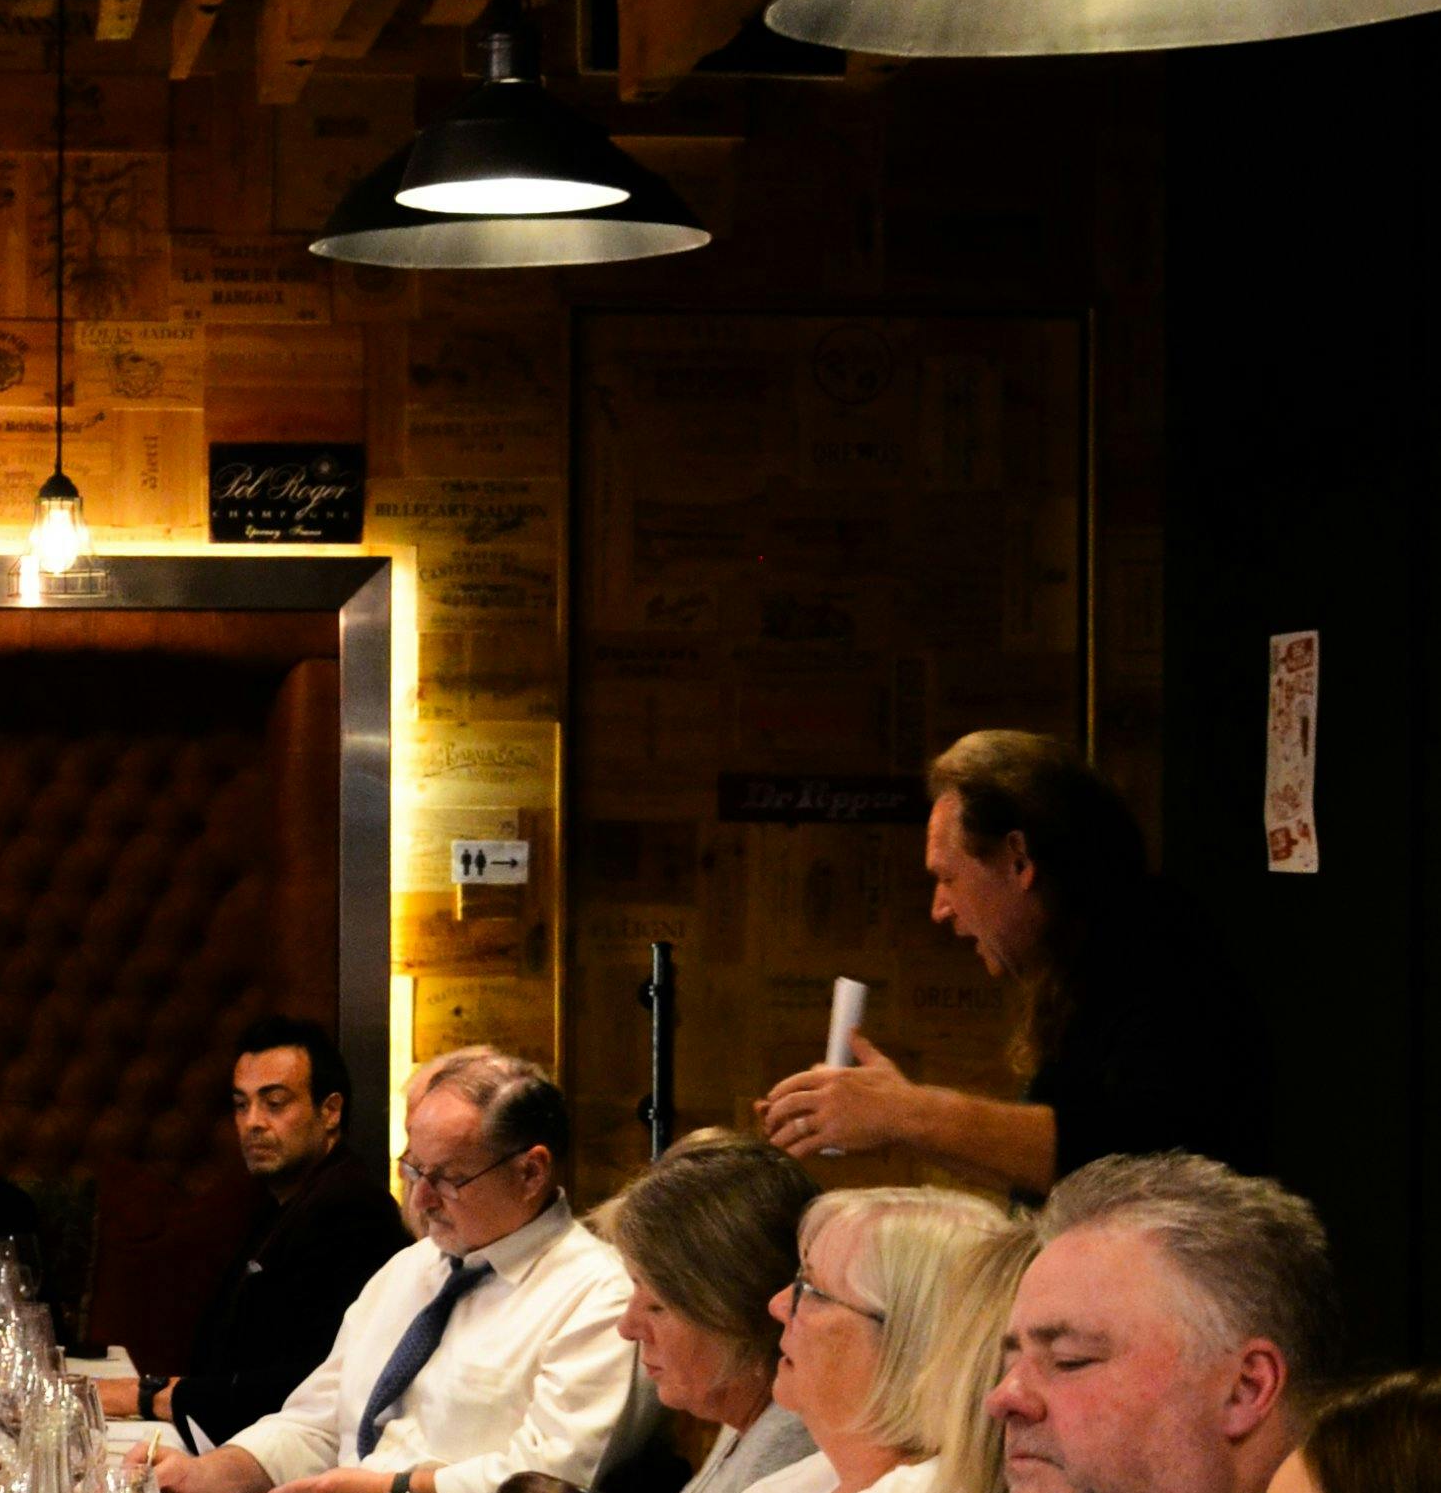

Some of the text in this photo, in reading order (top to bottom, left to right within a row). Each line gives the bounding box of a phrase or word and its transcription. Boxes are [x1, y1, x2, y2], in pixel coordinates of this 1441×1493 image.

[182, 267, 204, 283] LA
[213, 462, 359, 521] Pol Roger
[213, 509, 350, 520] CHAMPGNE
[912, 985, 1004, 1010] OREMUS
